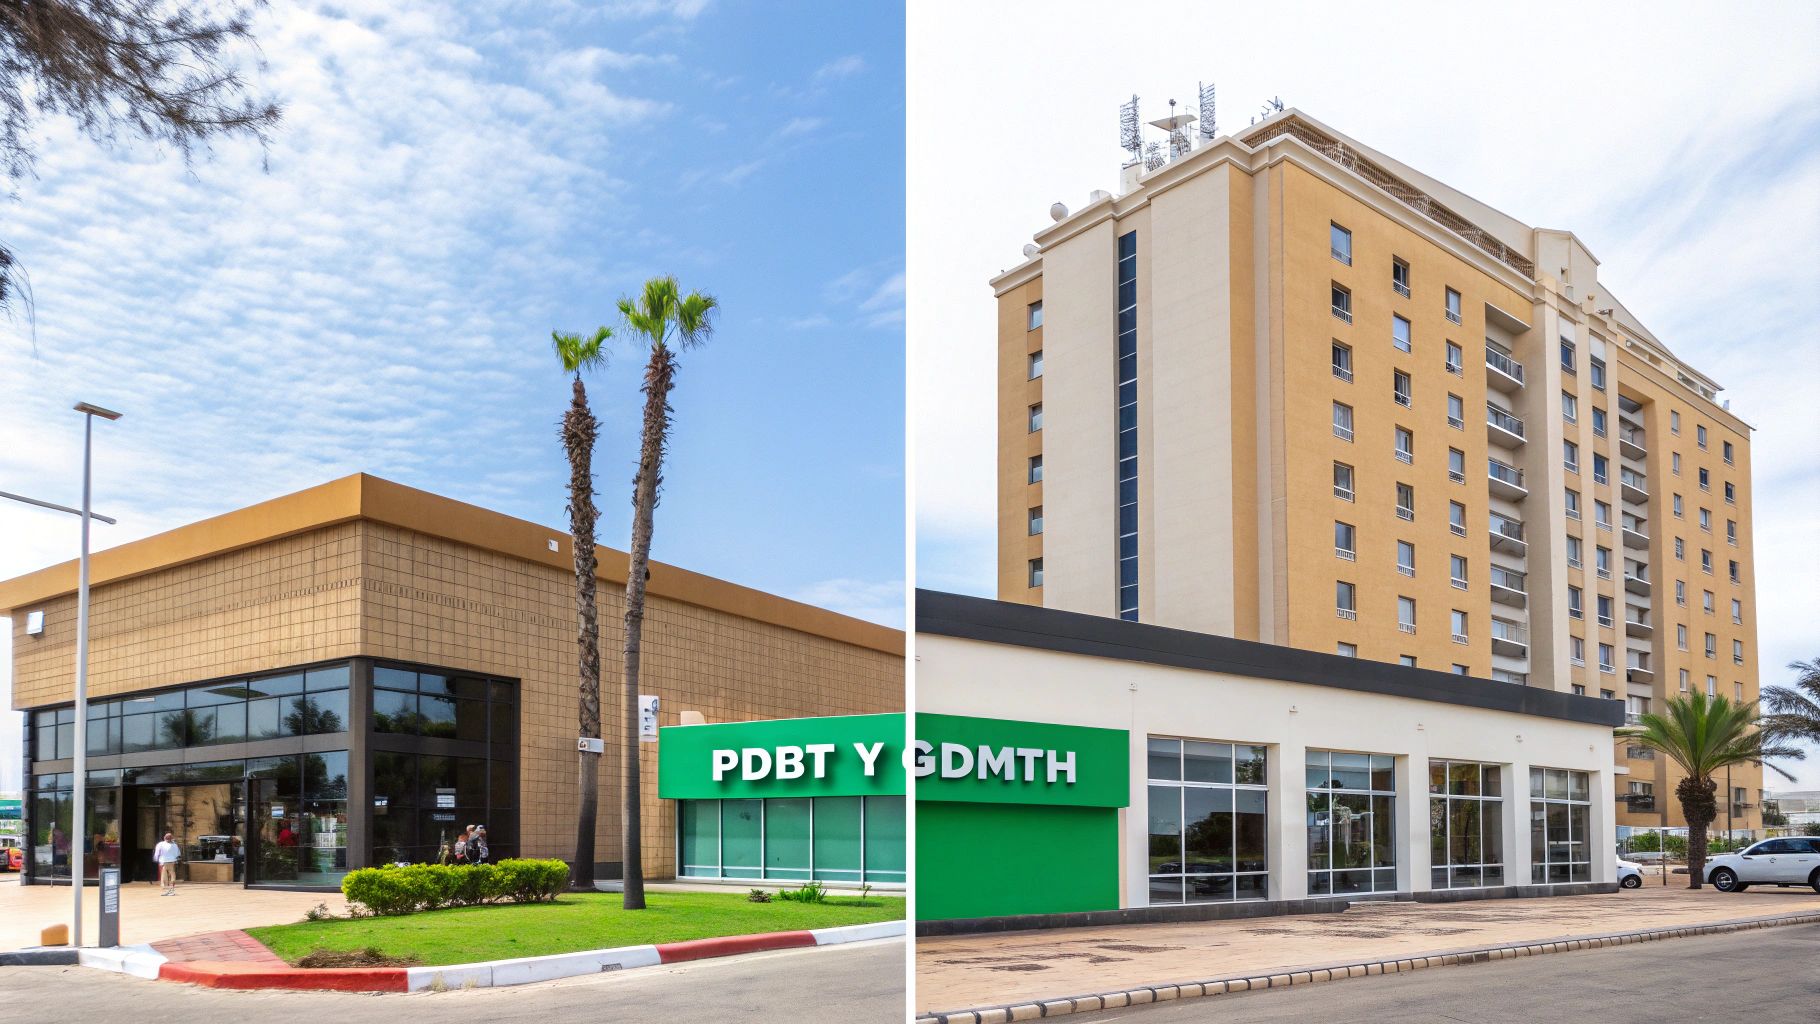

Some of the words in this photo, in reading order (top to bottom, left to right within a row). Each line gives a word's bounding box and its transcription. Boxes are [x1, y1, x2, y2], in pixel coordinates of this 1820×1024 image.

[712, 743, 835, 781] PDBT
[853, 742, 884, 776] Y
[902, 740, 1076, 782] GDMTH
